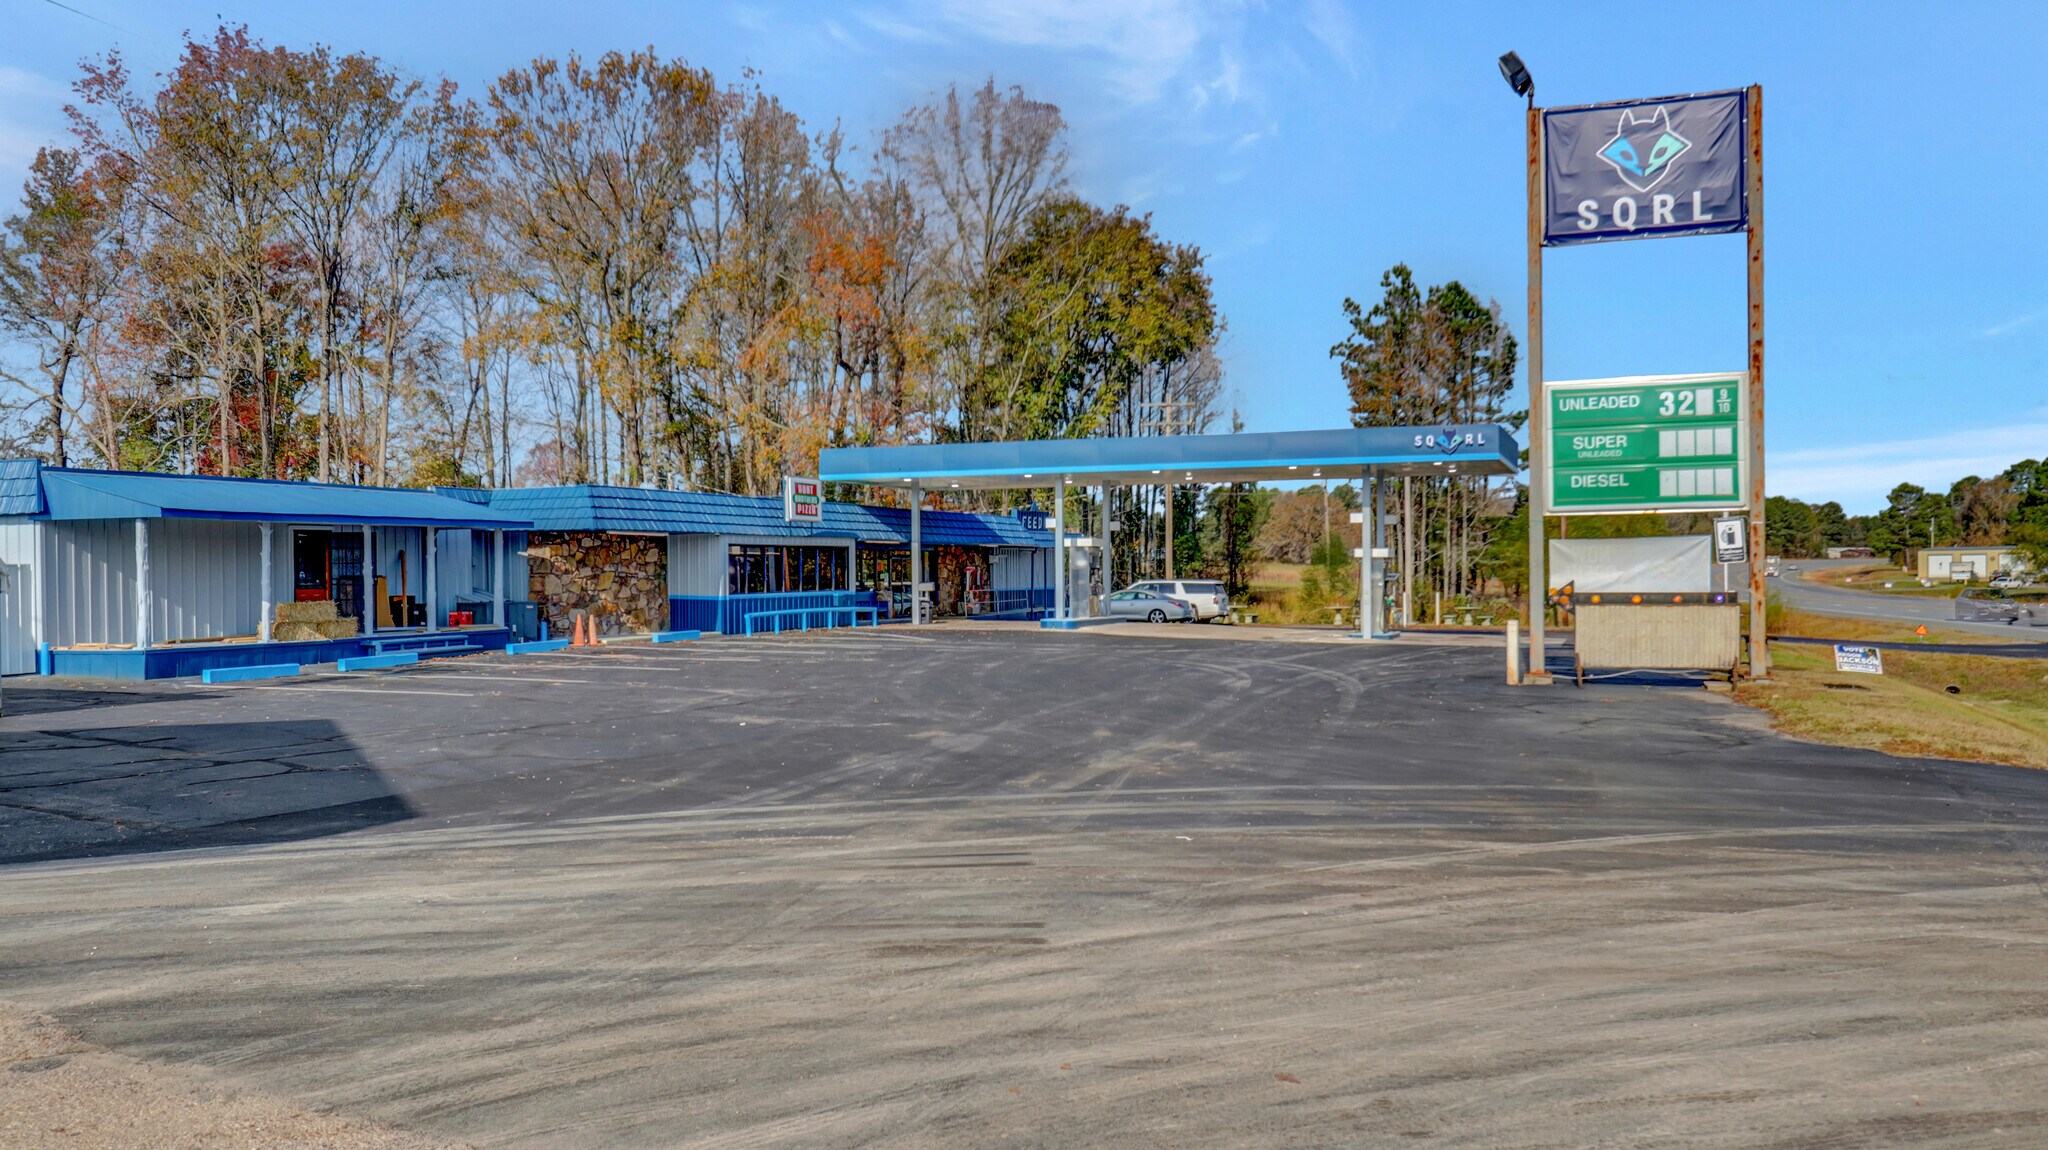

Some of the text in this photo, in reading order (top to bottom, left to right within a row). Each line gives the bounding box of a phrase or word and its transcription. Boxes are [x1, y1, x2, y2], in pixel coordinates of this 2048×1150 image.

[1577, 190, 1713, 232] SQRL
[1559, 395, 1640, 411] UNLEADED
[1572, 435, 1627, 450] SUPER
[1577, 450, 1623, 459] UNLEADED
[1570, 474, 1629, 488] DIESEL
[1022, 515, 1043, 530] FEED
